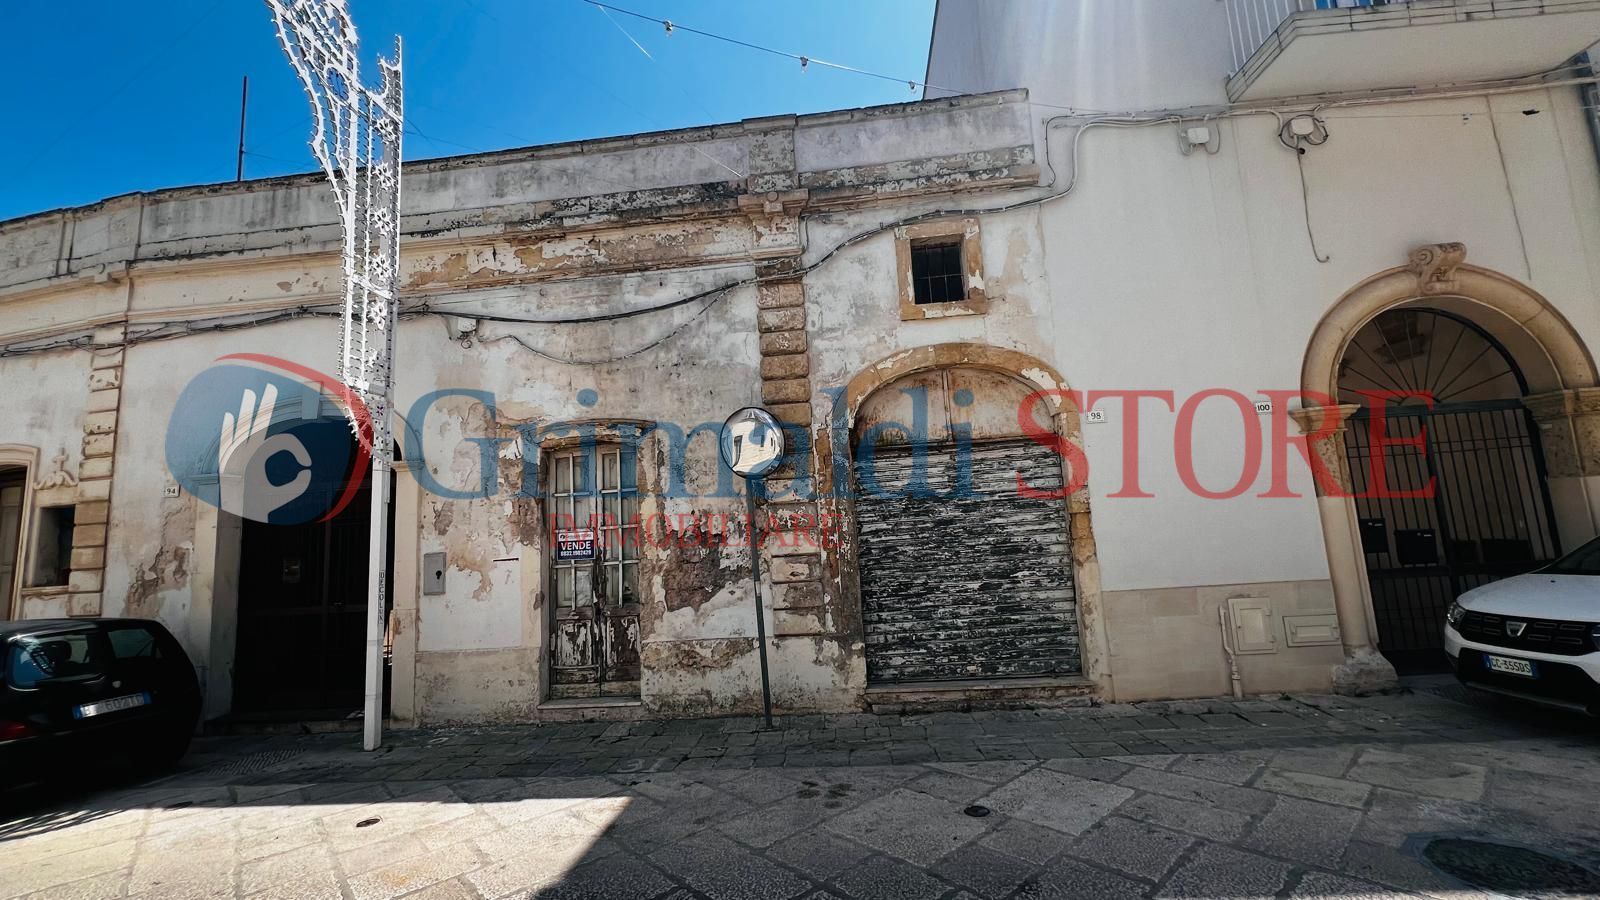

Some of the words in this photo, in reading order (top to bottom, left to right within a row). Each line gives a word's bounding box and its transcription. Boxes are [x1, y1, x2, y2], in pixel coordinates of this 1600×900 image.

[1256, 404, 1271, 412] 100
[1090, 411, 1102, 420] 98
[560, 541, 592, 551] VENDE
